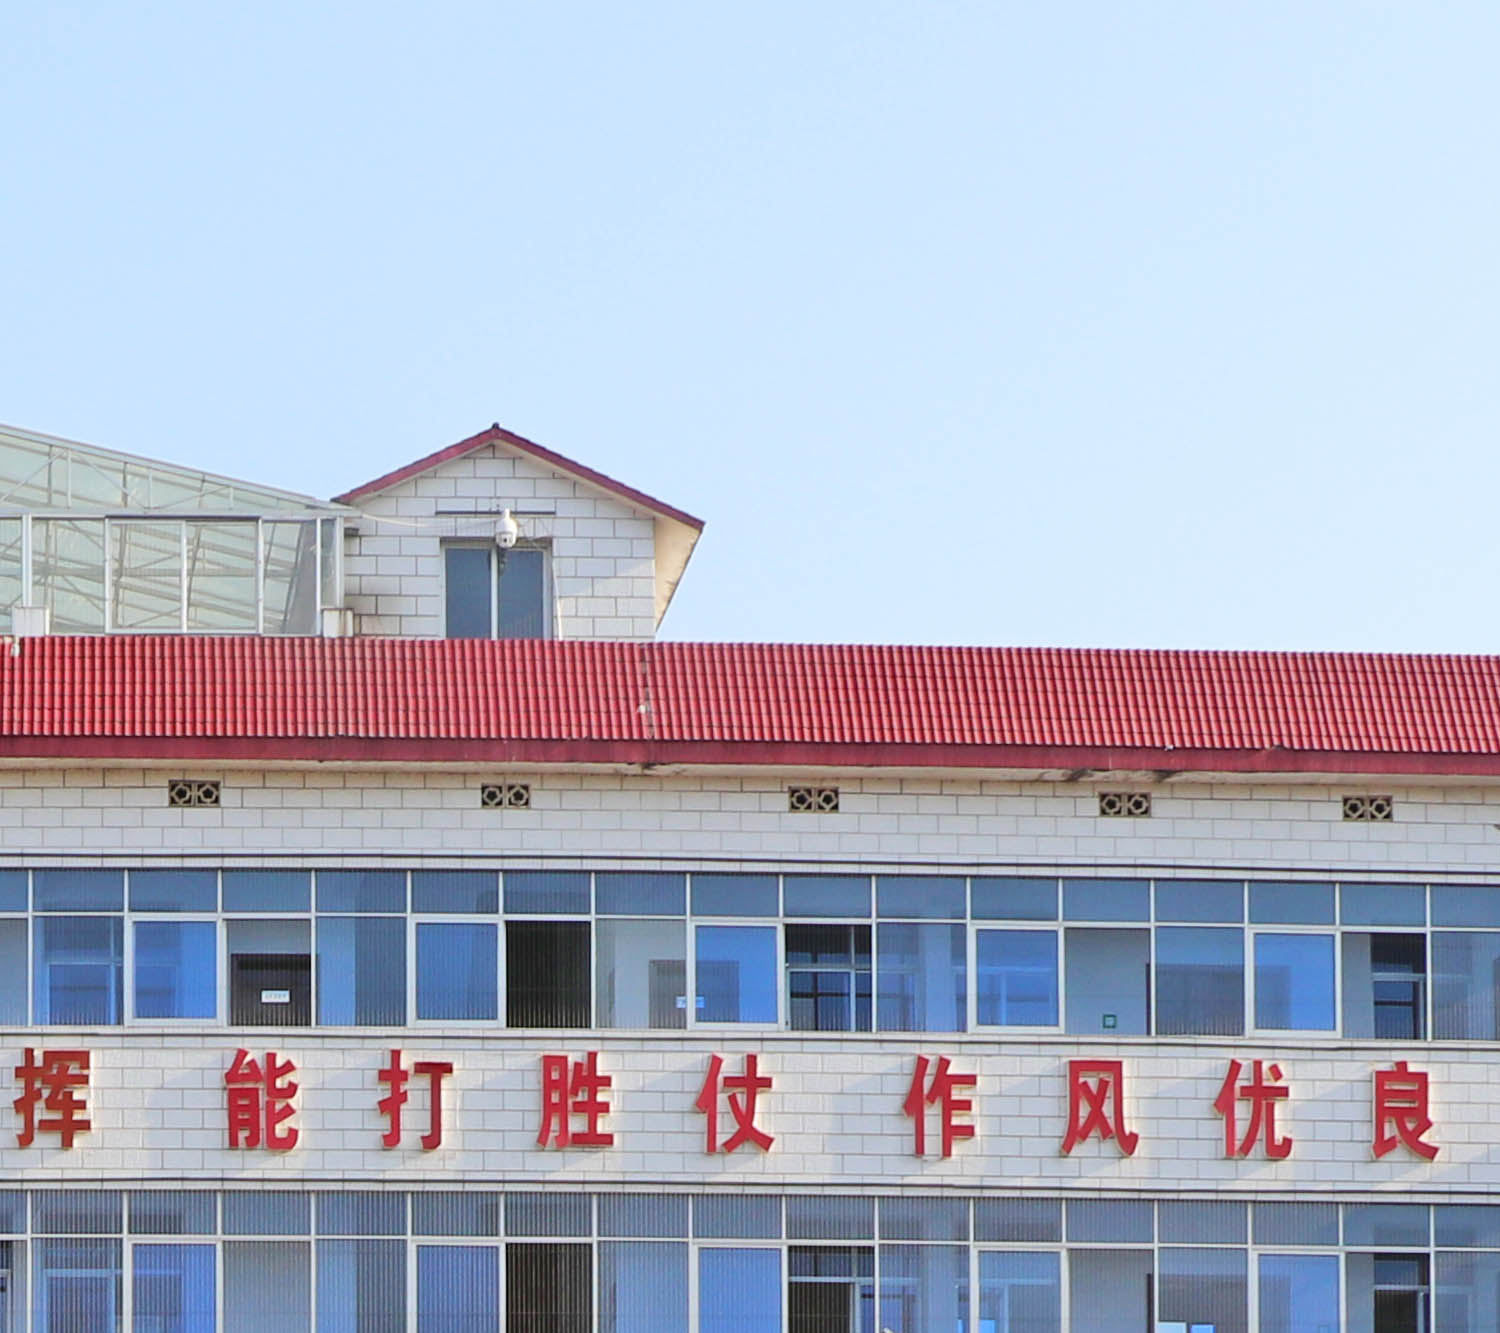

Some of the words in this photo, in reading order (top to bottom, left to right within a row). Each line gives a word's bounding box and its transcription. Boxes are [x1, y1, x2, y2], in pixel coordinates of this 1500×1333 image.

[223, 1047, 775, 1154] 能打胜仗
[902, 1054, 1440, 1160] 作风优良
